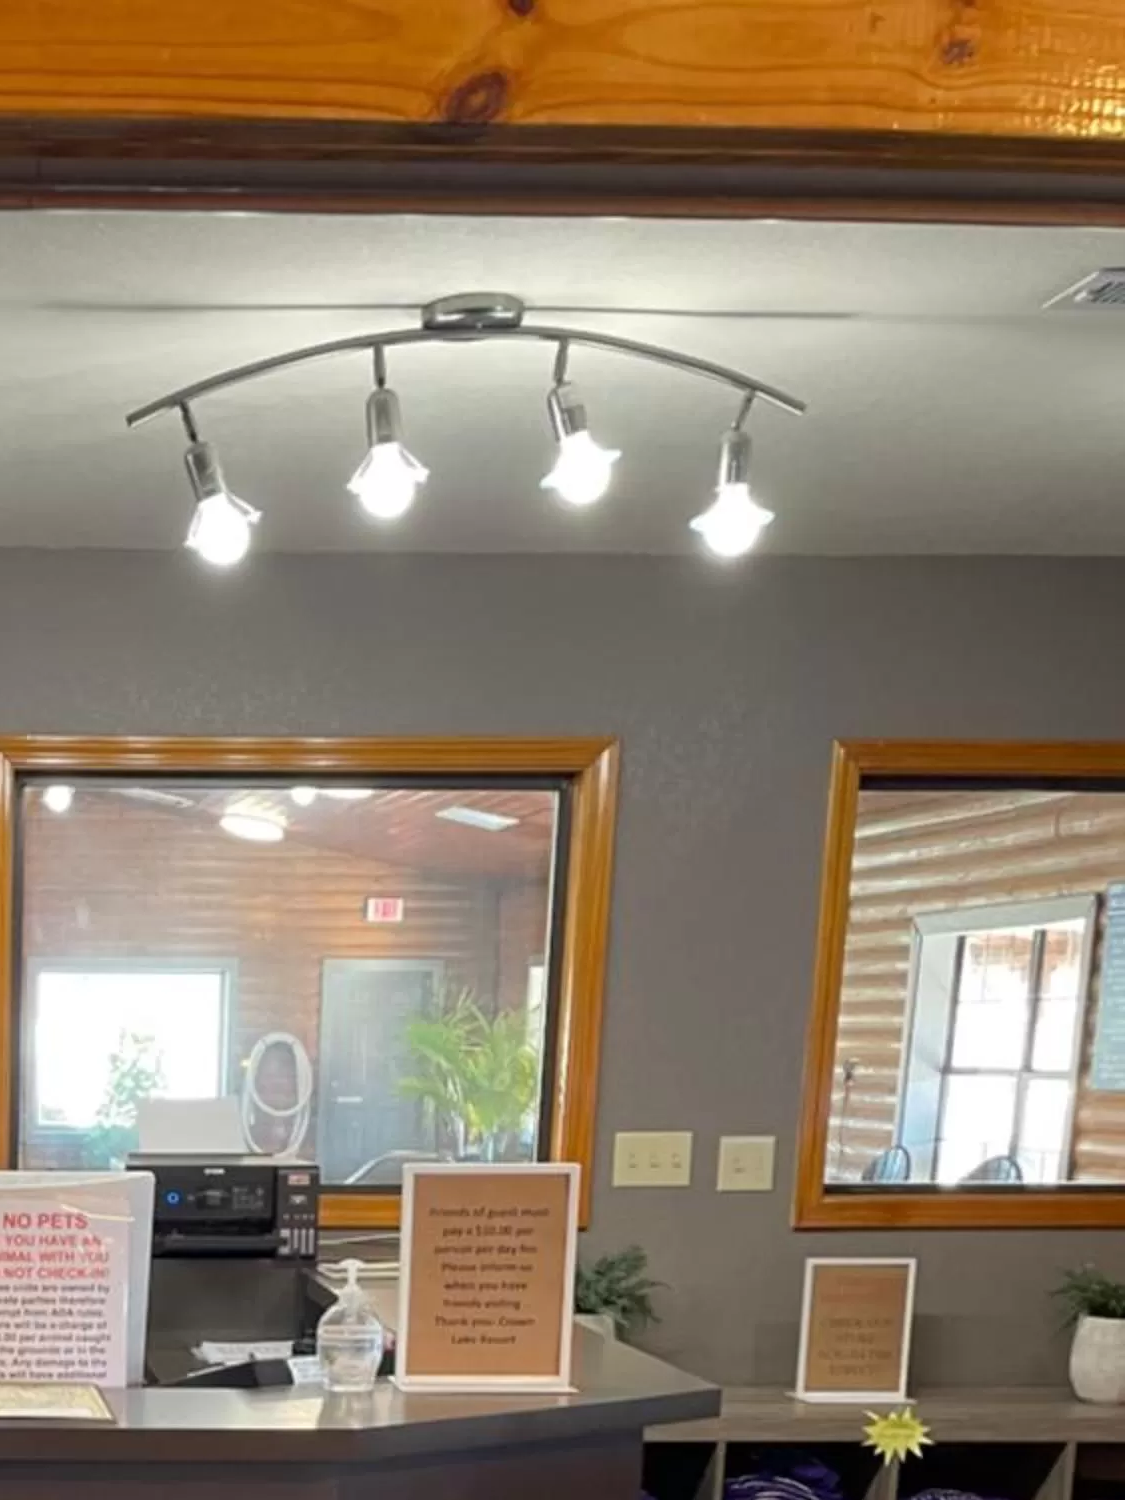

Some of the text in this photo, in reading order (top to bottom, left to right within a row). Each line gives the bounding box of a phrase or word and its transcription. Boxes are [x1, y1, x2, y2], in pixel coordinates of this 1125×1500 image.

[2, 1213, 88, 1229] NO PETS
[5, 1234, 35, 1246] YOU
[39, 1234, 77, 1246] HAVE
[81, 1234, 102, 1246] AN
[39, 1251, 75, 1262] WITH
[80, 1251, 109, 1262] YOU
[3, 1267, 32, 1279] NOT
[51, 1308, 73, 1318] ADA
